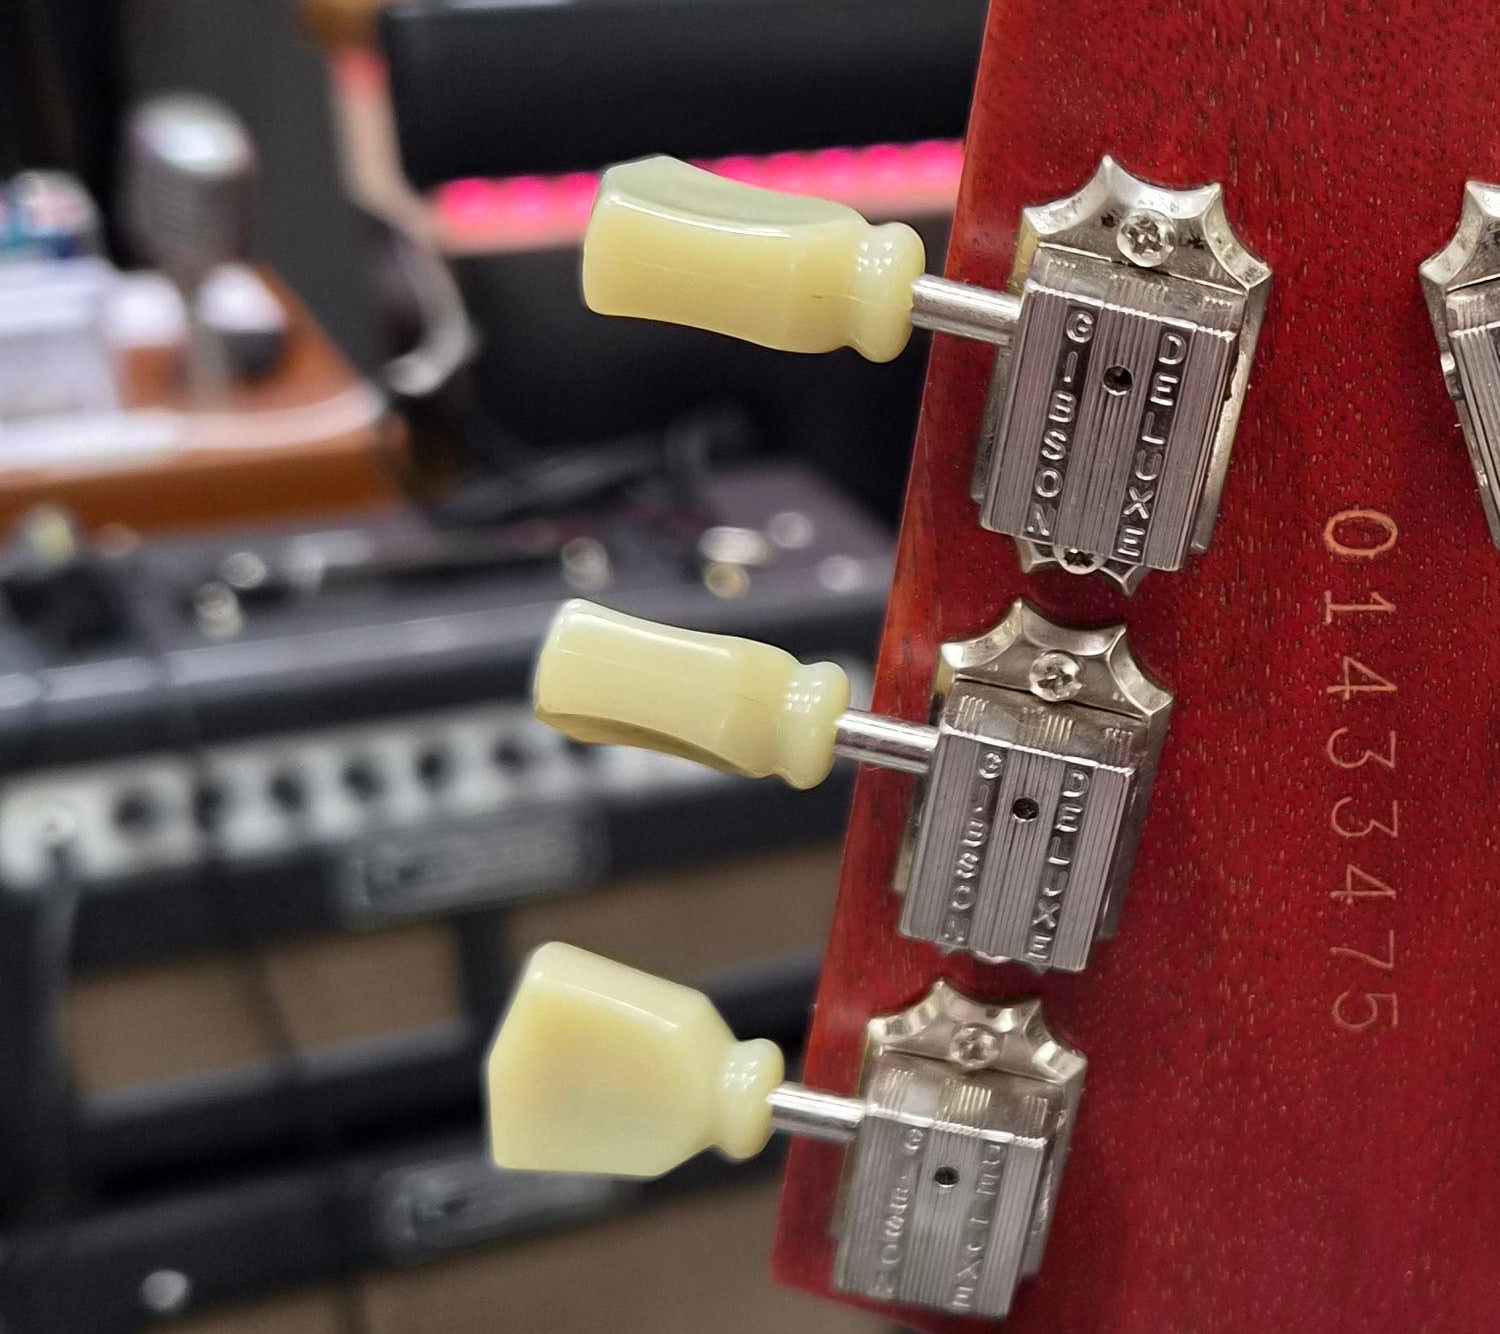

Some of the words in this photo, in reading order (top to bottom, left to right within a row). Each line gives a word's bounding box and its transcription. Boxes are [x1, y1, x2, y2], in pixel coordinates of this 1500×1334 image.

[1028, 311, 1093, 536] GIBSON
[1118, 333, 1187, 557] DELUXE
[943, 751, 1003, 944] GIBSON
[1027, 770, 1089, 960] DELUXE
[1323, 509, 1399, 1029] 01433475
[874, 1128, 925, 1295] GBSO
